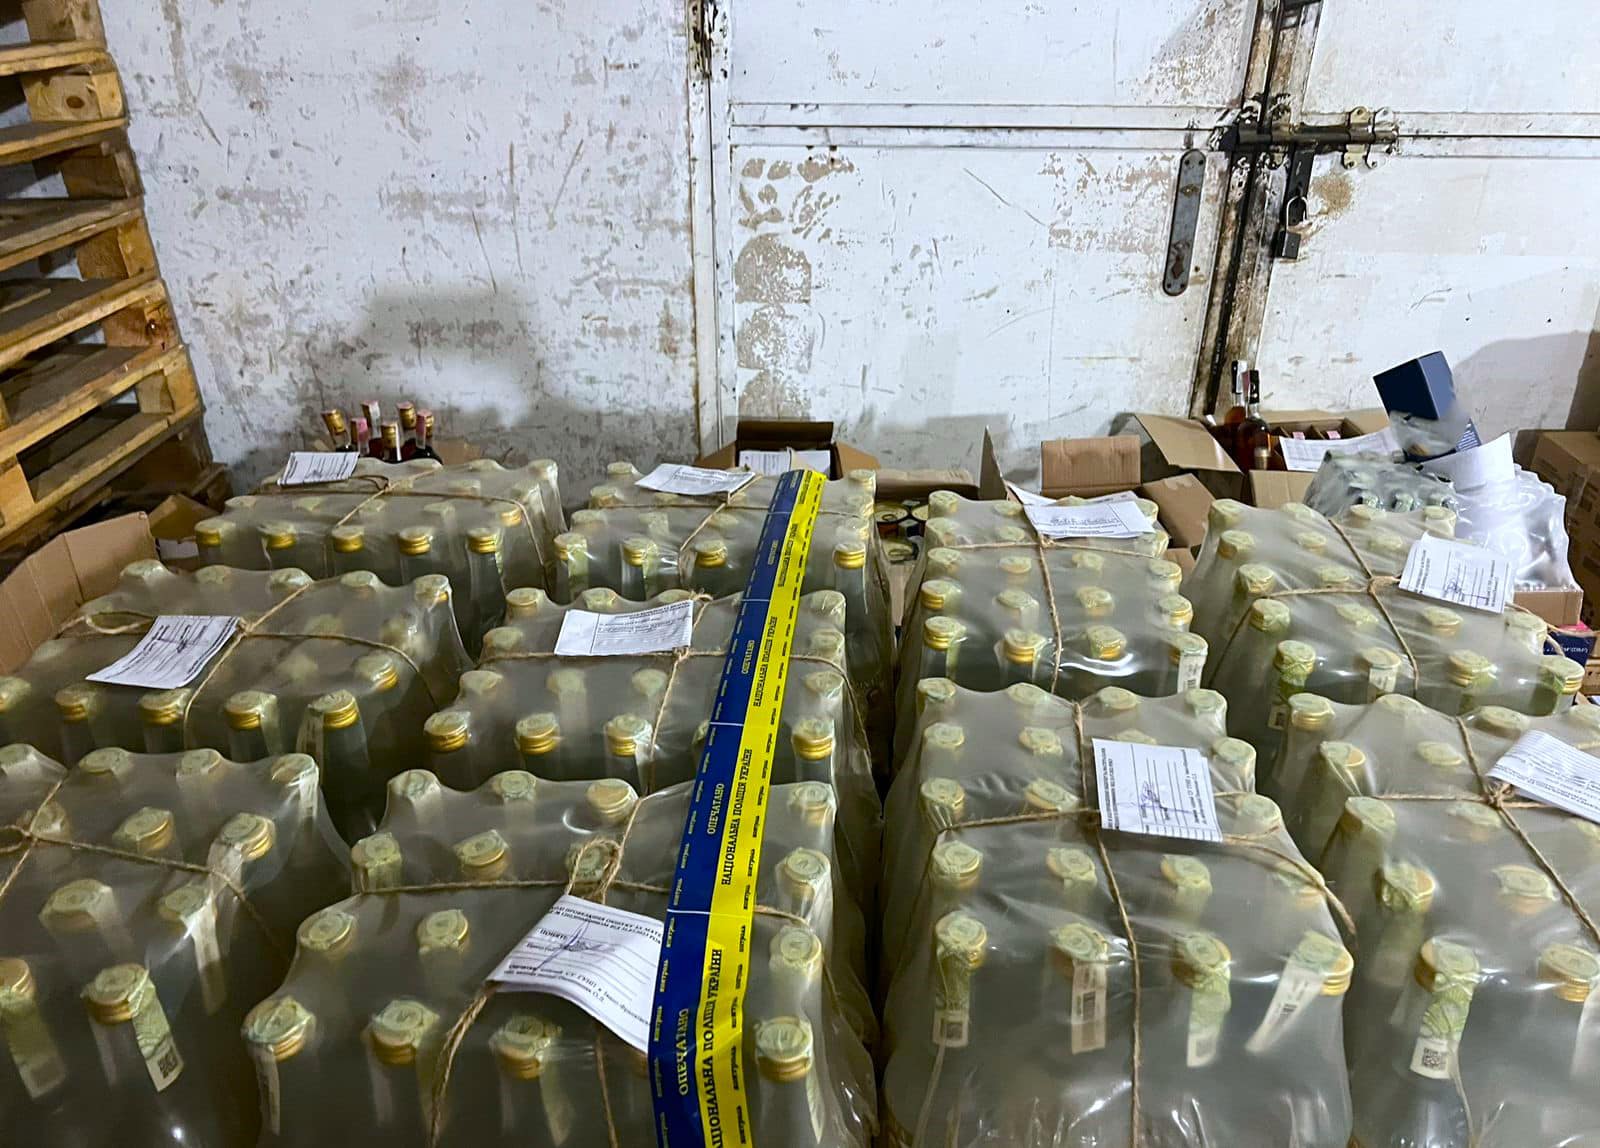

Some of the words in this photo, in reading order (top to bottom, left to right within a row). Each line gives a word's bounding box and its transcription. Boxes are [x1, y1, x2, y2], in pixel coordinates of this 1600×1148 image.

[707, 783, 725, 834] ОПЕЧАТАНО
[721, 818, 741, 885] НАЦІОНАЛЬНА
[733, 782, 747, 816] ПОЛІЦІЯ
[740, 749, 753, 780] УКРАЇНИ
[676, 1008, 690, 1096] ОПЕЧАТАНО
